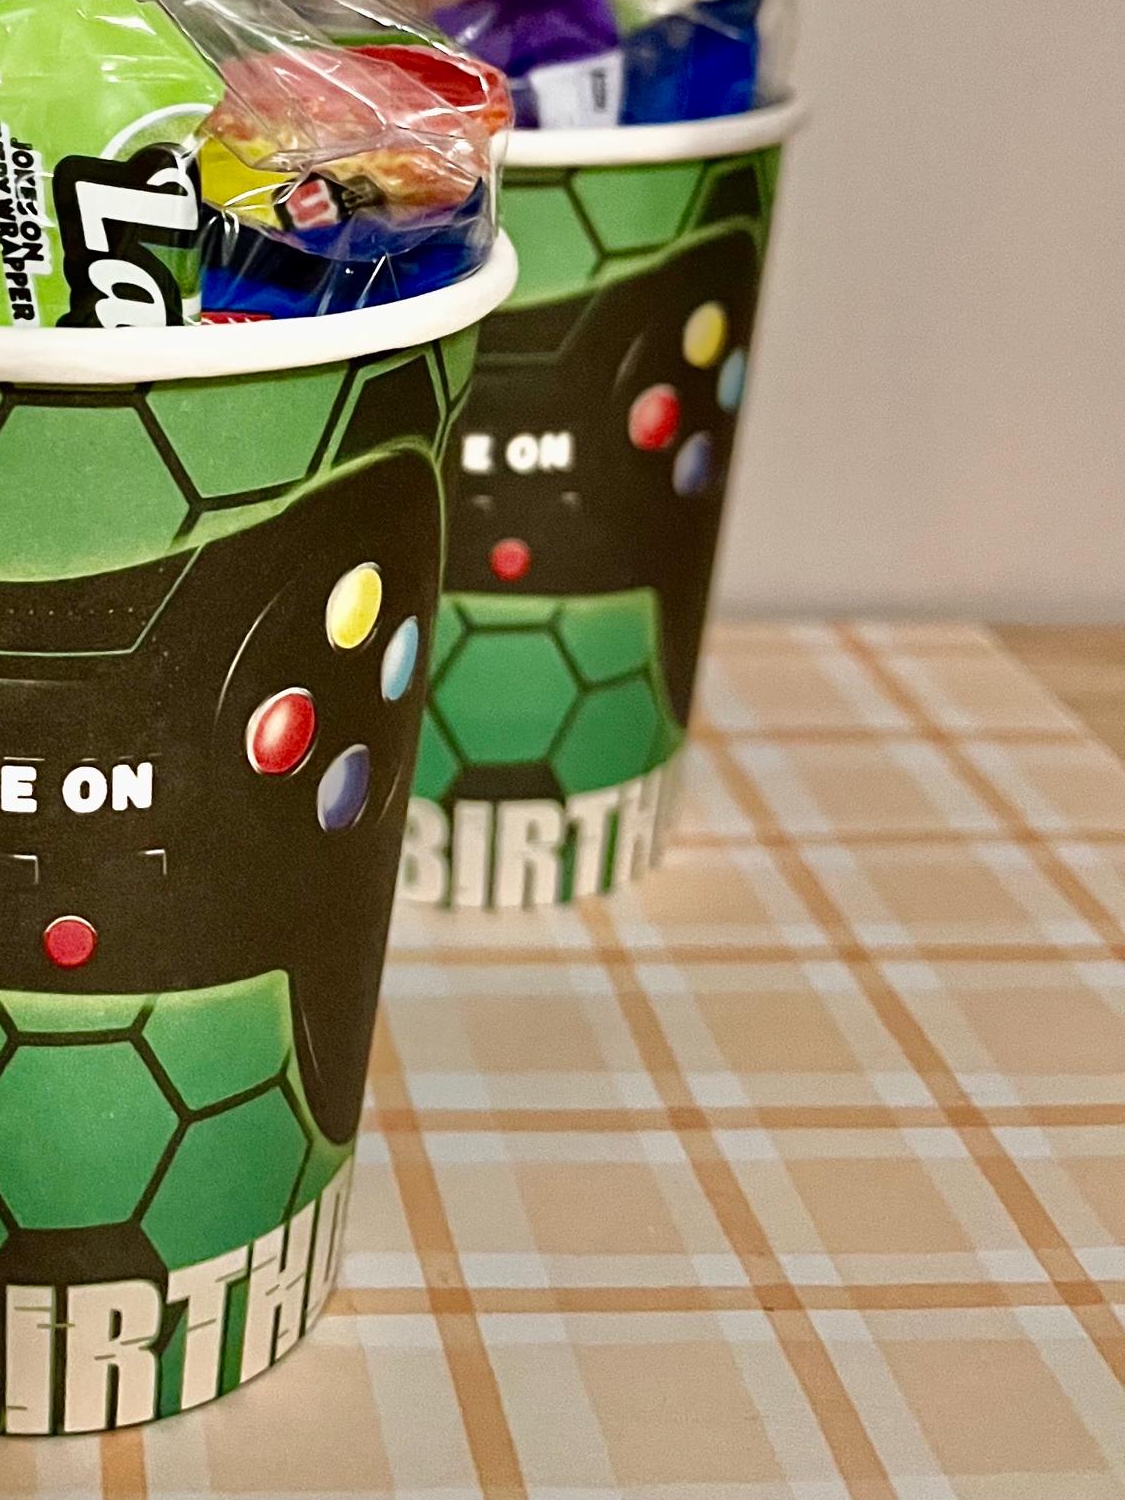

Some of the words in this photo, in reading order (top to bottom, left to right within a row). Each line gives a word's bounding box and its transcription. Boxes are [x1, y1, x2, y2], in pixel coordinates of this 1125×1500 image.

[10, 137, 39, 215] JOKES
[20, 221, 44, 262] ON
[505, 431, 572, 474] ON
[62, 761, 154, 814] ON
